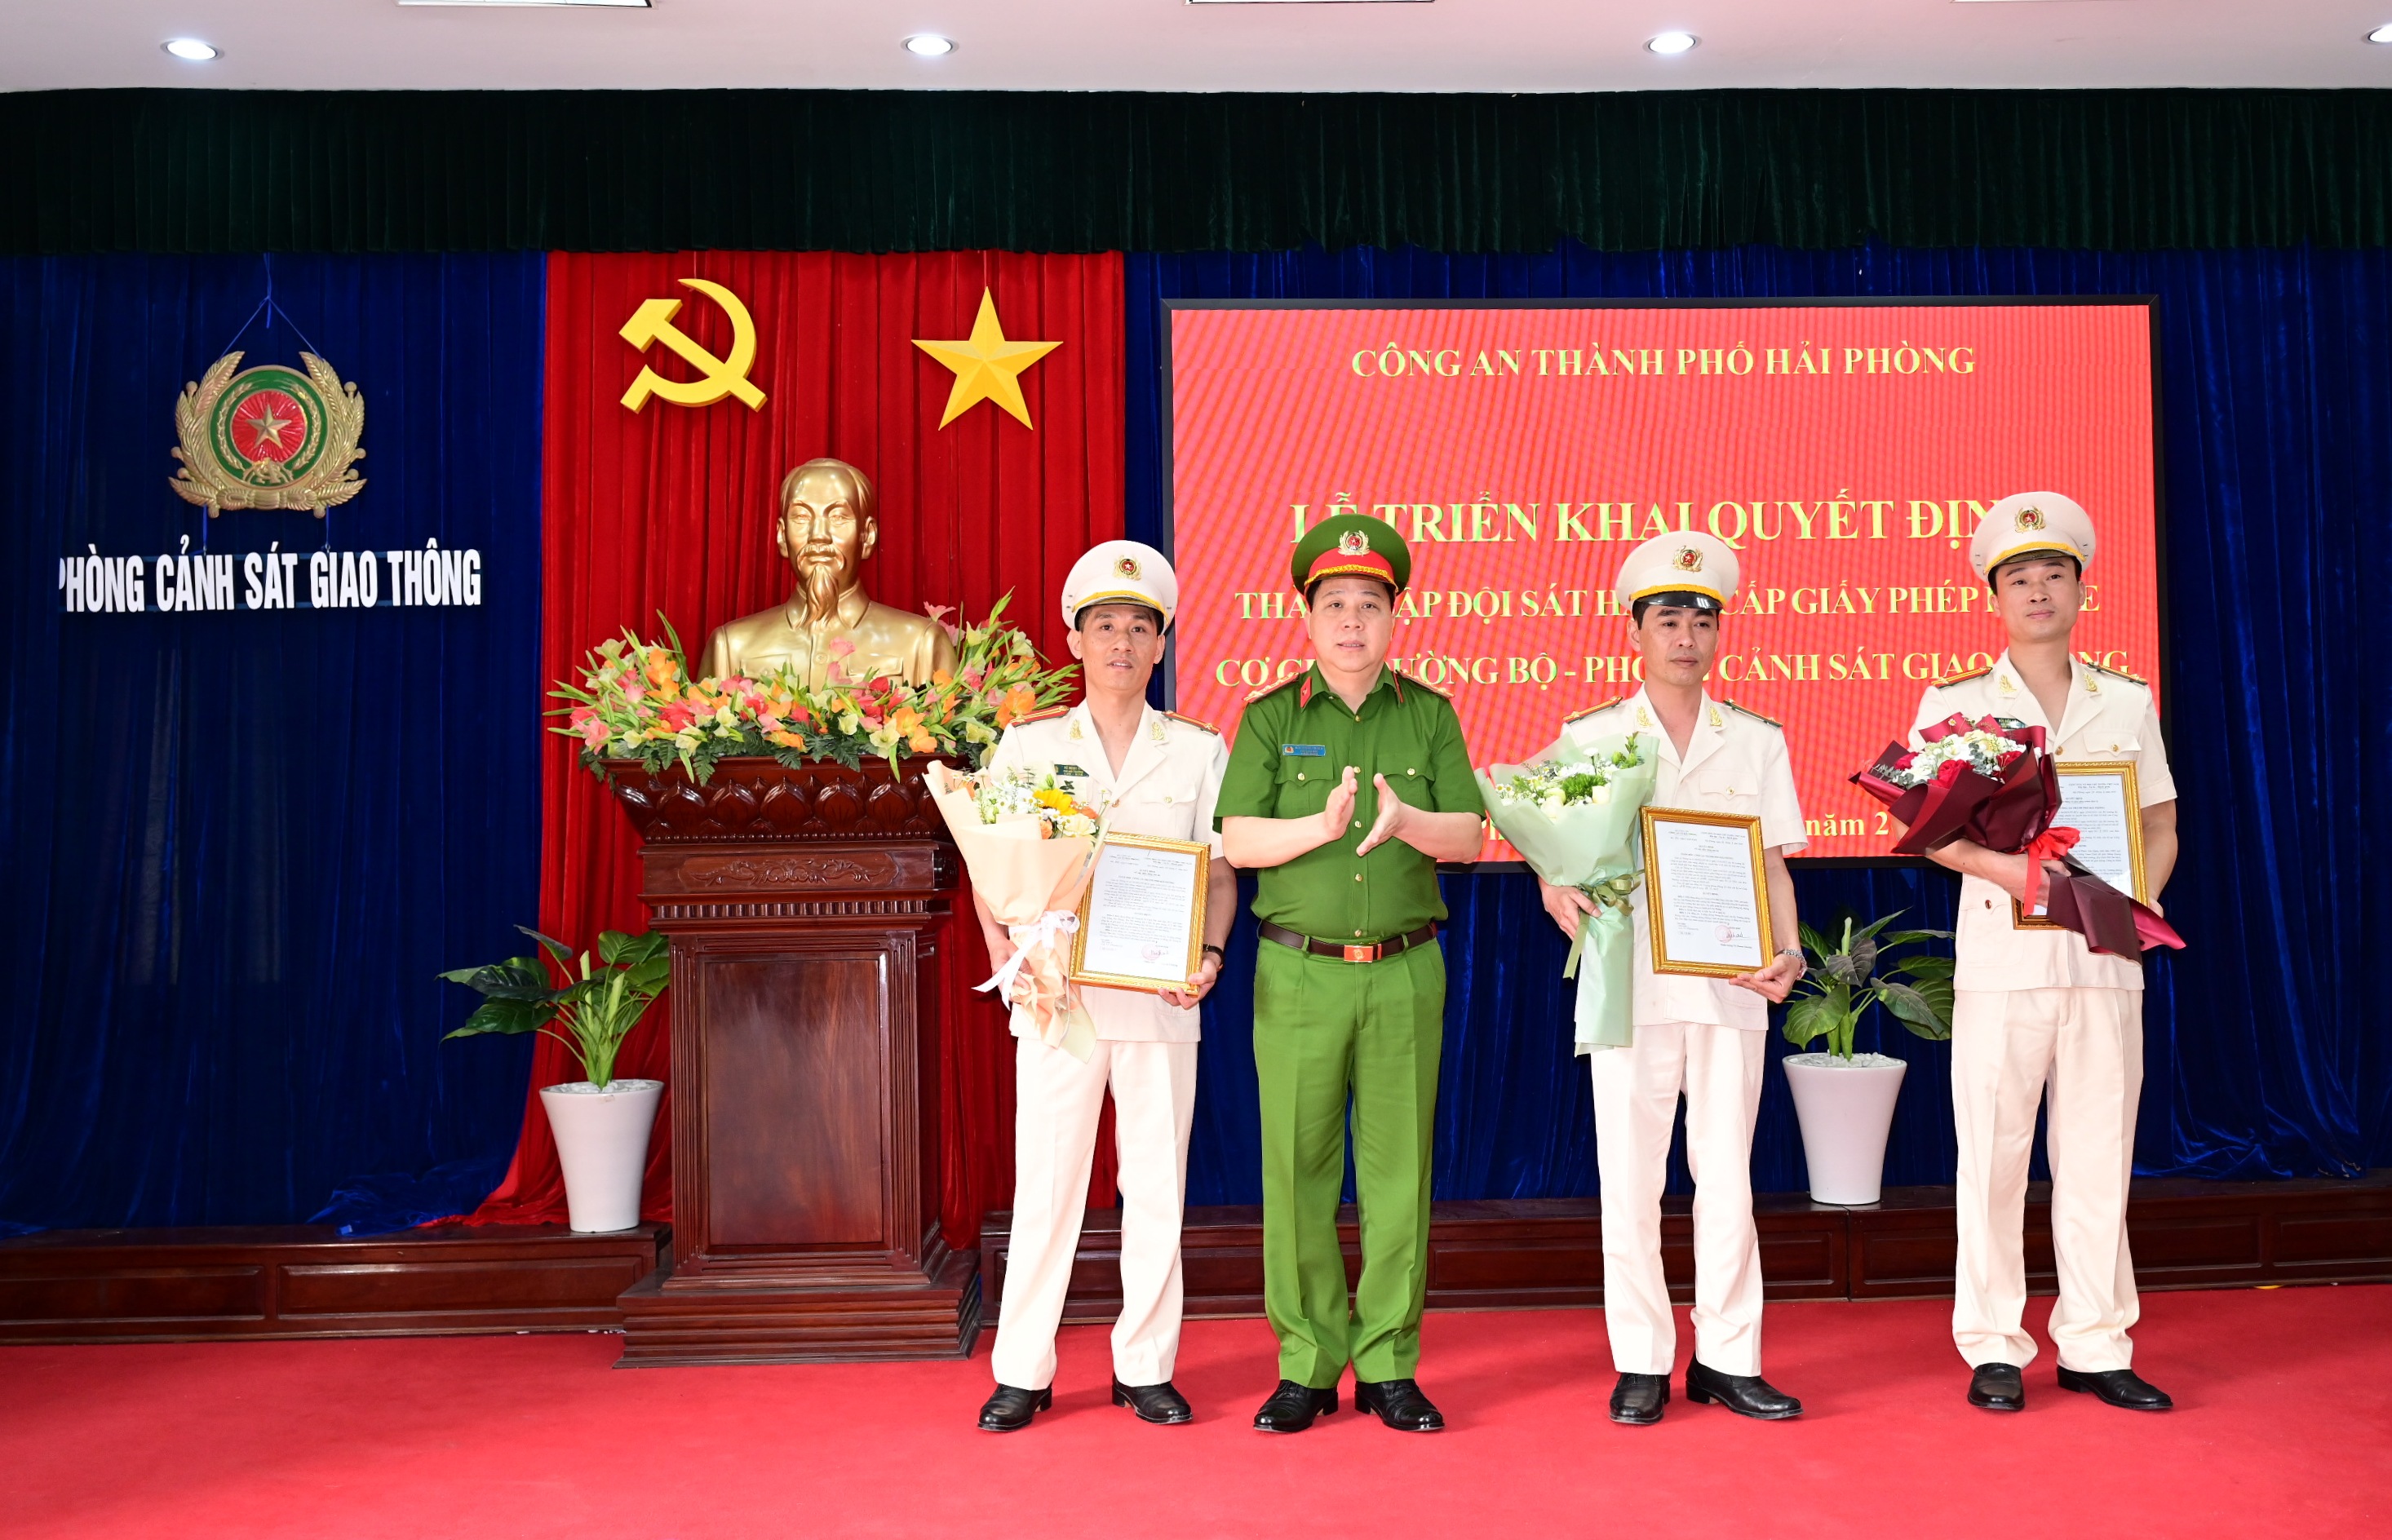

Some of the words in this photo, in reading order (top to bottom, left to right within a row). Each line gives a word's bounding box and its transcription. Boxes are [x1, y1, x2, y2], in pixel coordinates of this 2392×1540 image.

[1352, 341, 1460, 378] CÔNG
[1470, 348, 1522, 377] AN
[1530, 342, 1664, 376] THÀNH
[1677, 340, 1754, 375] PHỐ
[1766, 340, 1831, 374] HẢI
[1844, 340, 1976, 374] PHÒNG
[1373, 491, 1540, 542] TRIỂN
[1555, 502, 1693, 542] KHAI
[1708, 488, 1894, 550] QUYẾT
[156, 534, 235, 612] CẢNH
[243, 541, 298, 610] SÁT
[309, 550, 378, 609] GIAO
[387, 537, 481, 607] THÔNG
[1394, 586, 1442, 626] ẬP
[1447, 586, 1511, 626] ĐỘI
[1521, 582, 1588, 618] SÁT
[1791, 579, 1880, 616] GIẤY
[1889, 579, 1979, 613] PHÉP
[1216, 656, 1271, 687] CƠ
[1508, 653, 1557, 691] BỘ
[1719, 647, 1820, 682] CẢNH
[1829, 645, 1896, 680] SÁT
[1903, 652, 1994, 683] GIAO
[1804, 812, 1865, 837] năm
